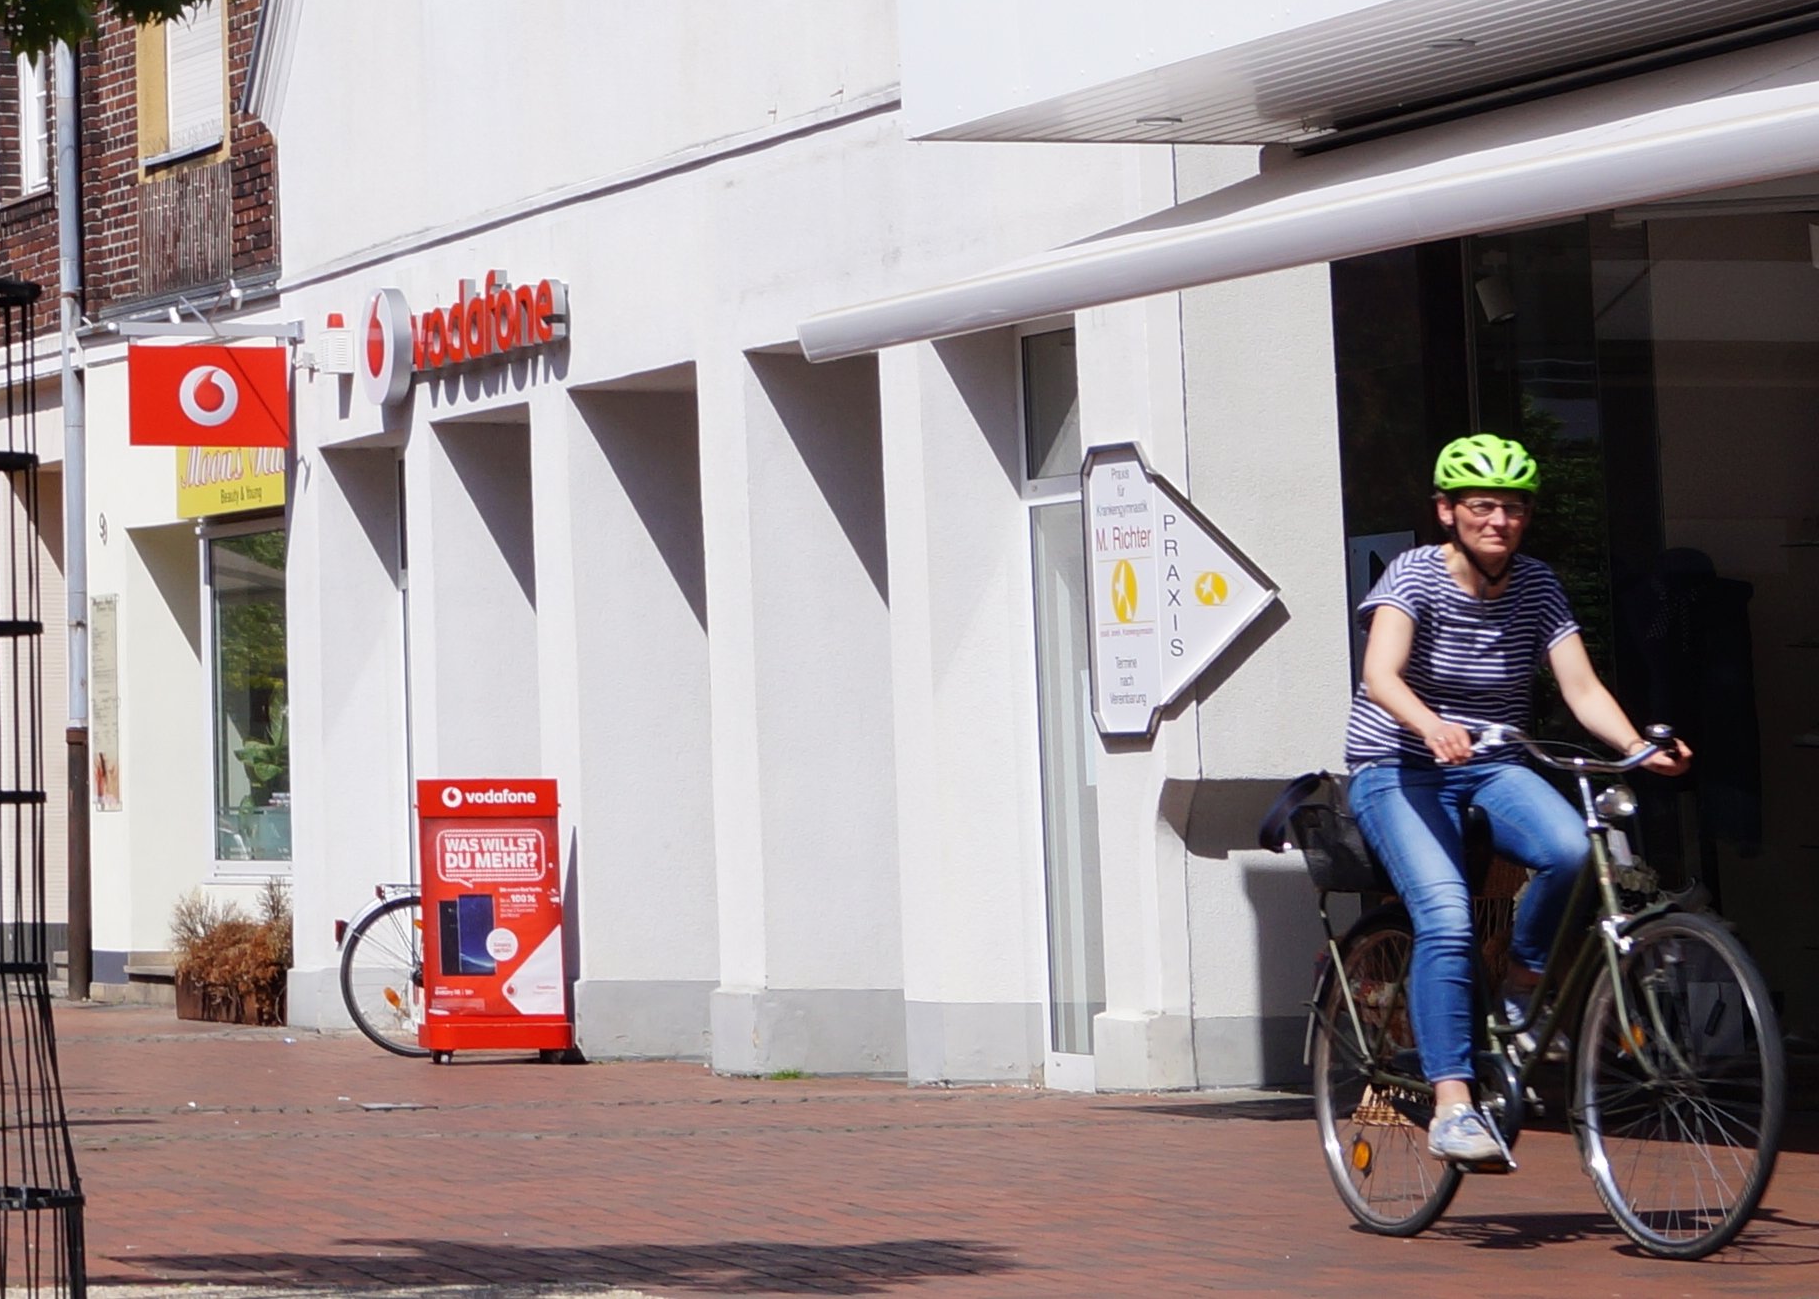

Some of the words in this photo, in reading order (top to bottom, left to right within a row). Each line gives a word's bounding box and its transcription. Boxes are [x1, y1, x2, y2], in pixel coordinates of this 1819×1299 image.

[411, 269, 557, 370] vodafone
[1095, 527, 1108, 552] M.
[1112, 525, 1152, 551] Richter
[1163, 514, 1184, 656] PRAXIS
[465, 788, 536, 804] vodafone
[445, 838, 479, 852] WAS
[481, 838, 536, 852] WILLST
[445, 853, 470, 868] DU
[475, 853, 538, 868] MEHR?
